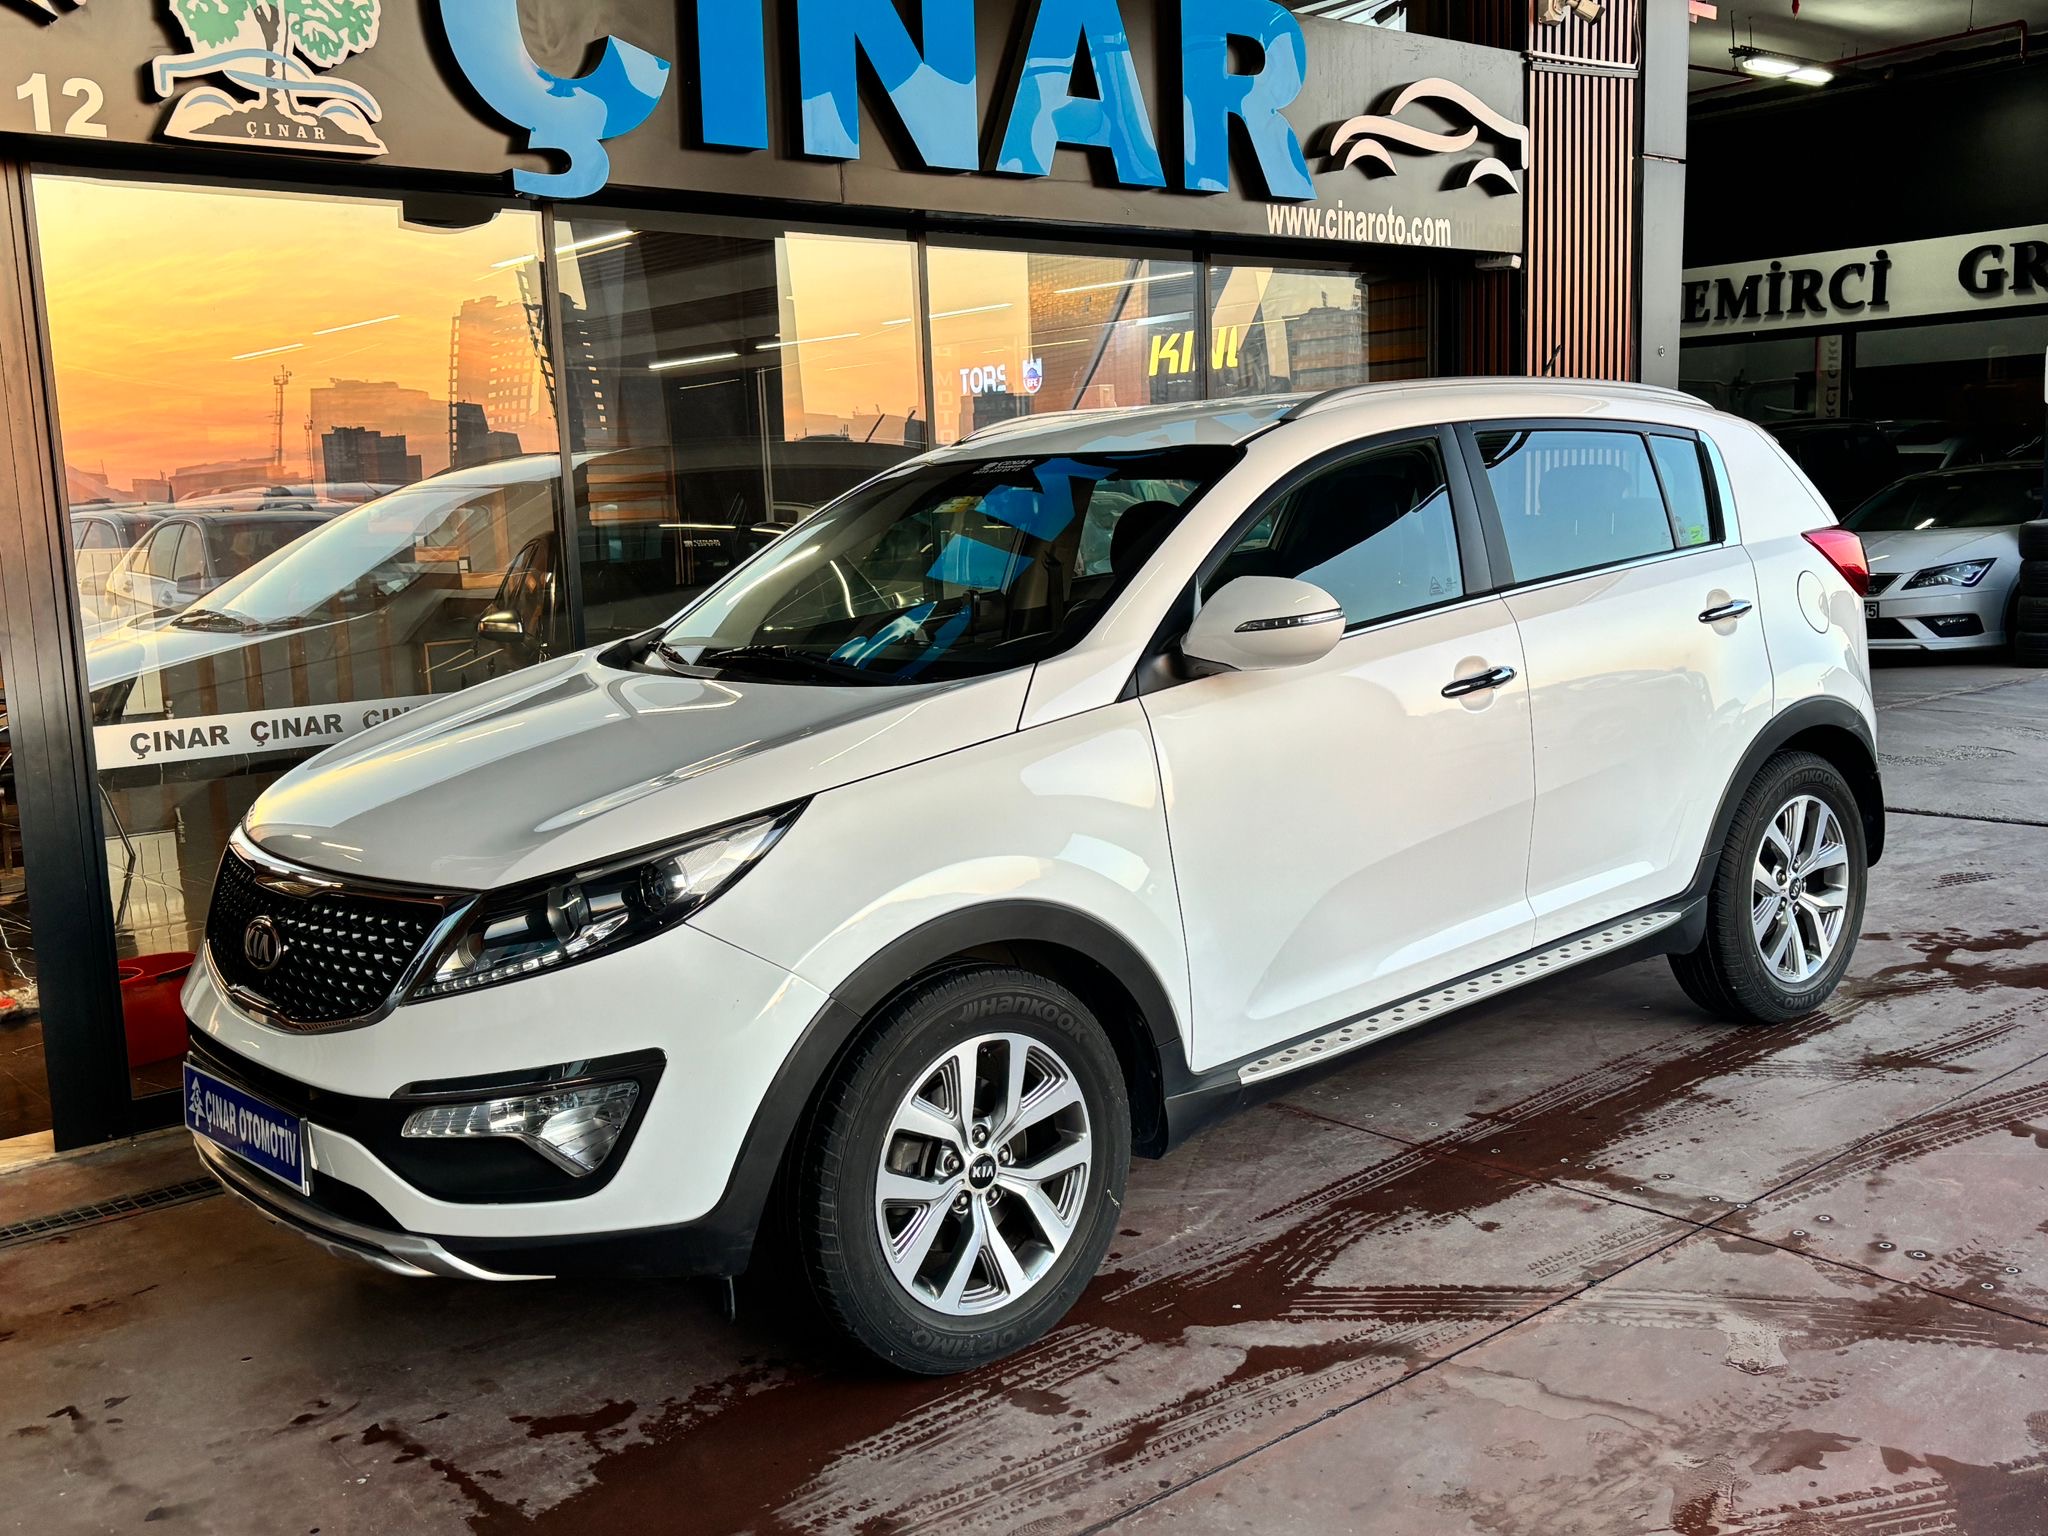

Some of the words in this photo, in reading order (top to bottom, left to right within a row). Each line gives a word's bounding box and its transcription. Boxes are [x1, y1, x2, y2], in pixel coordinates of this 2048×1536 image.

[16, 73, 108, 138] 12
[440, 0, 1317, 199] ÇINAR
[246, 121, 327, 141] ÇINAR
[1266, 200, 1451, 247] www.cinaroto.com
[130, 724, 230, 760] ÇINAR
[250, 713, 344, 747] ÇINAR
[205, 1090, 237, 1136] ÇINAR
[239, 1106, 296, 1167] OTOMOTİV
[972, 1165, 994, 1178] KIA
